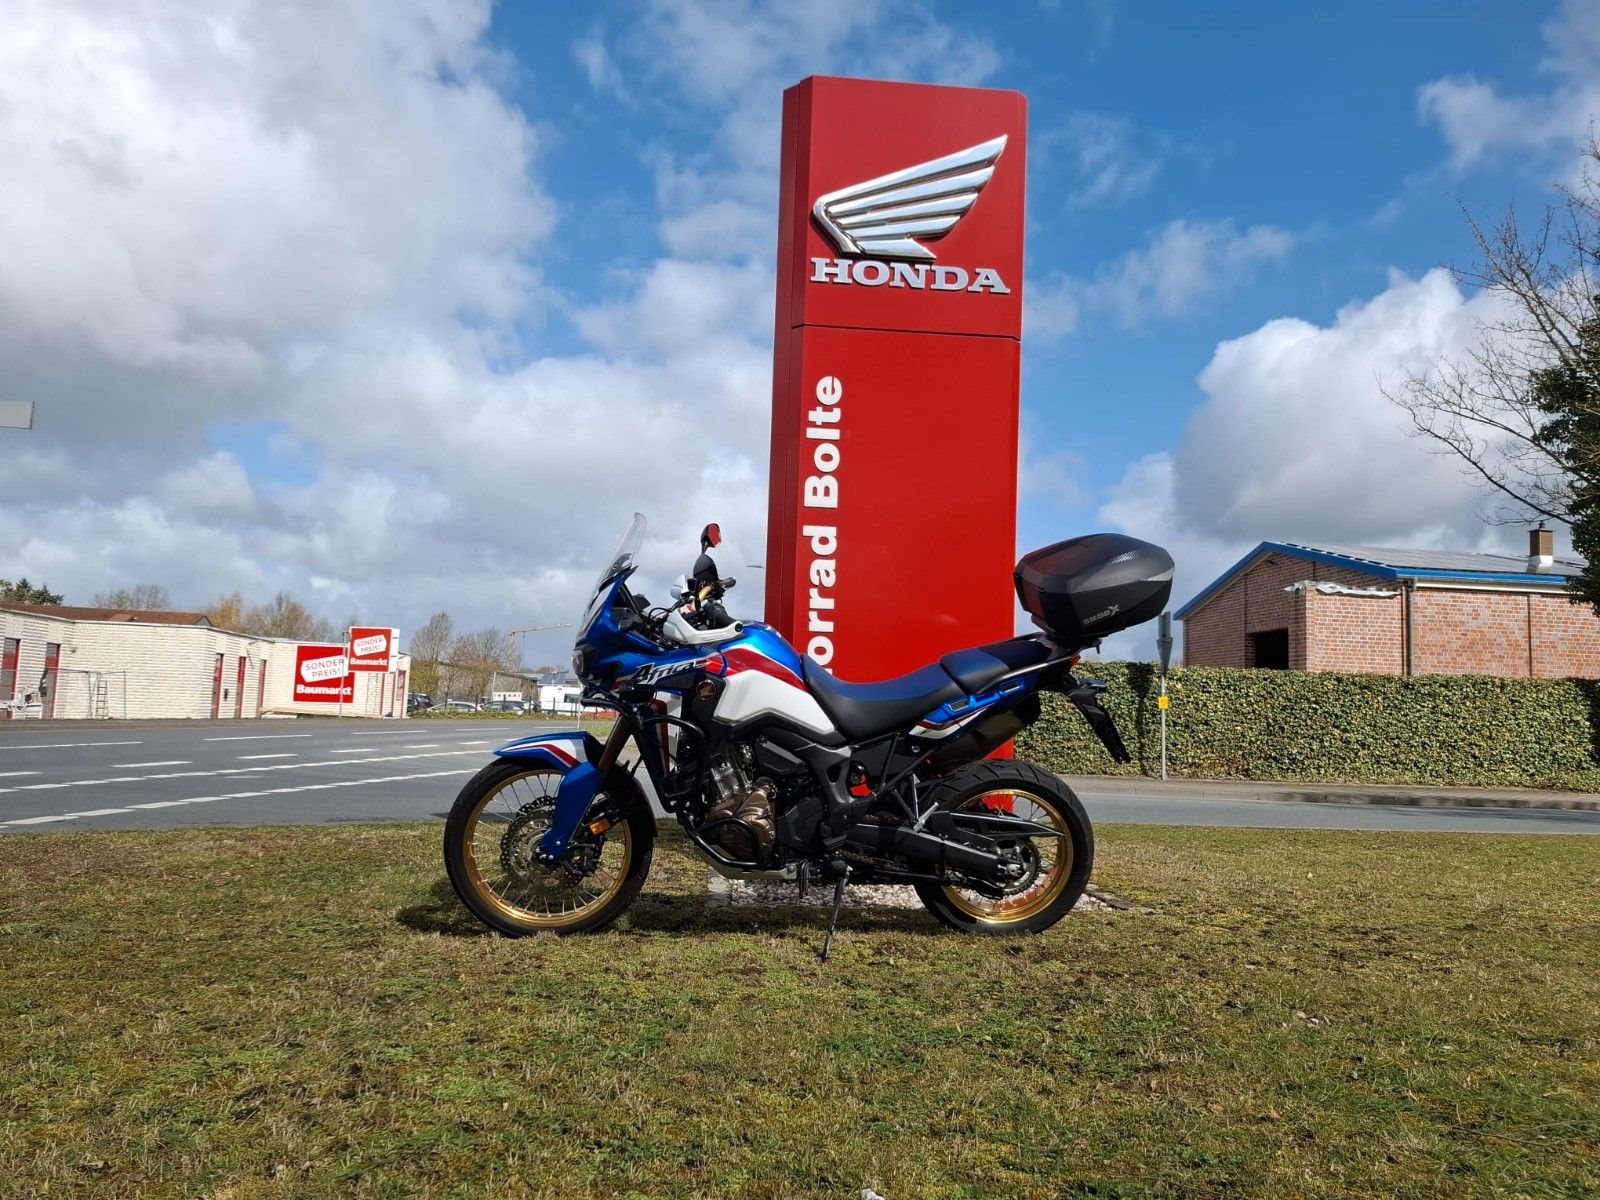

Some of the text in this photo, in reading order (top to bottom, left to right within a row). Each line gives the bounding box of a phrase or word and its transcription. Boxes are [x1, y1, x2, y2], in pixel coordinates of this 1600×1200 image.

[810, 257, 1011, 294] HONDA
[802, 375, 842, 673] orrad Bolte
[356, 637, 382, 647] SONDER
[305, 658, 344, 671] SONDER
[350, 658, 388, 666] Baumarkt
[312, 668, 341, 679] PREIS!
